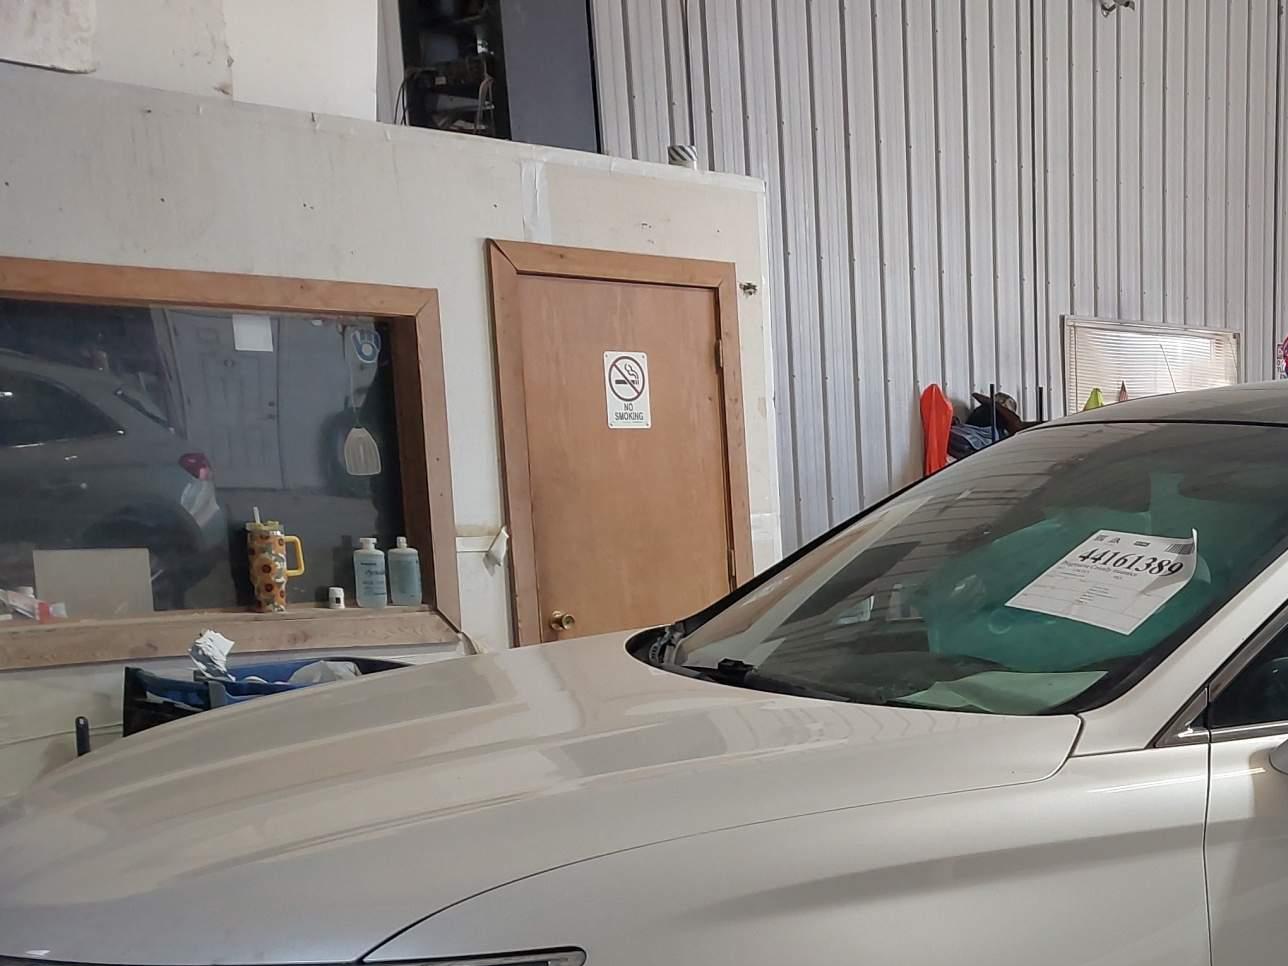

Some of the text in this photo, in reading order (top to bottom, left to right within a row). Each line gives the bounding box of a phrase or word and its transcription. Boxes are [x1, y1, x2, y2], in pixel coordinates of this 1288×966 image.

[623, 402, 634, 412] NO
[614, 411, 644, 421] SMOKING
[1078, 548, 1184, 577] 44161389
